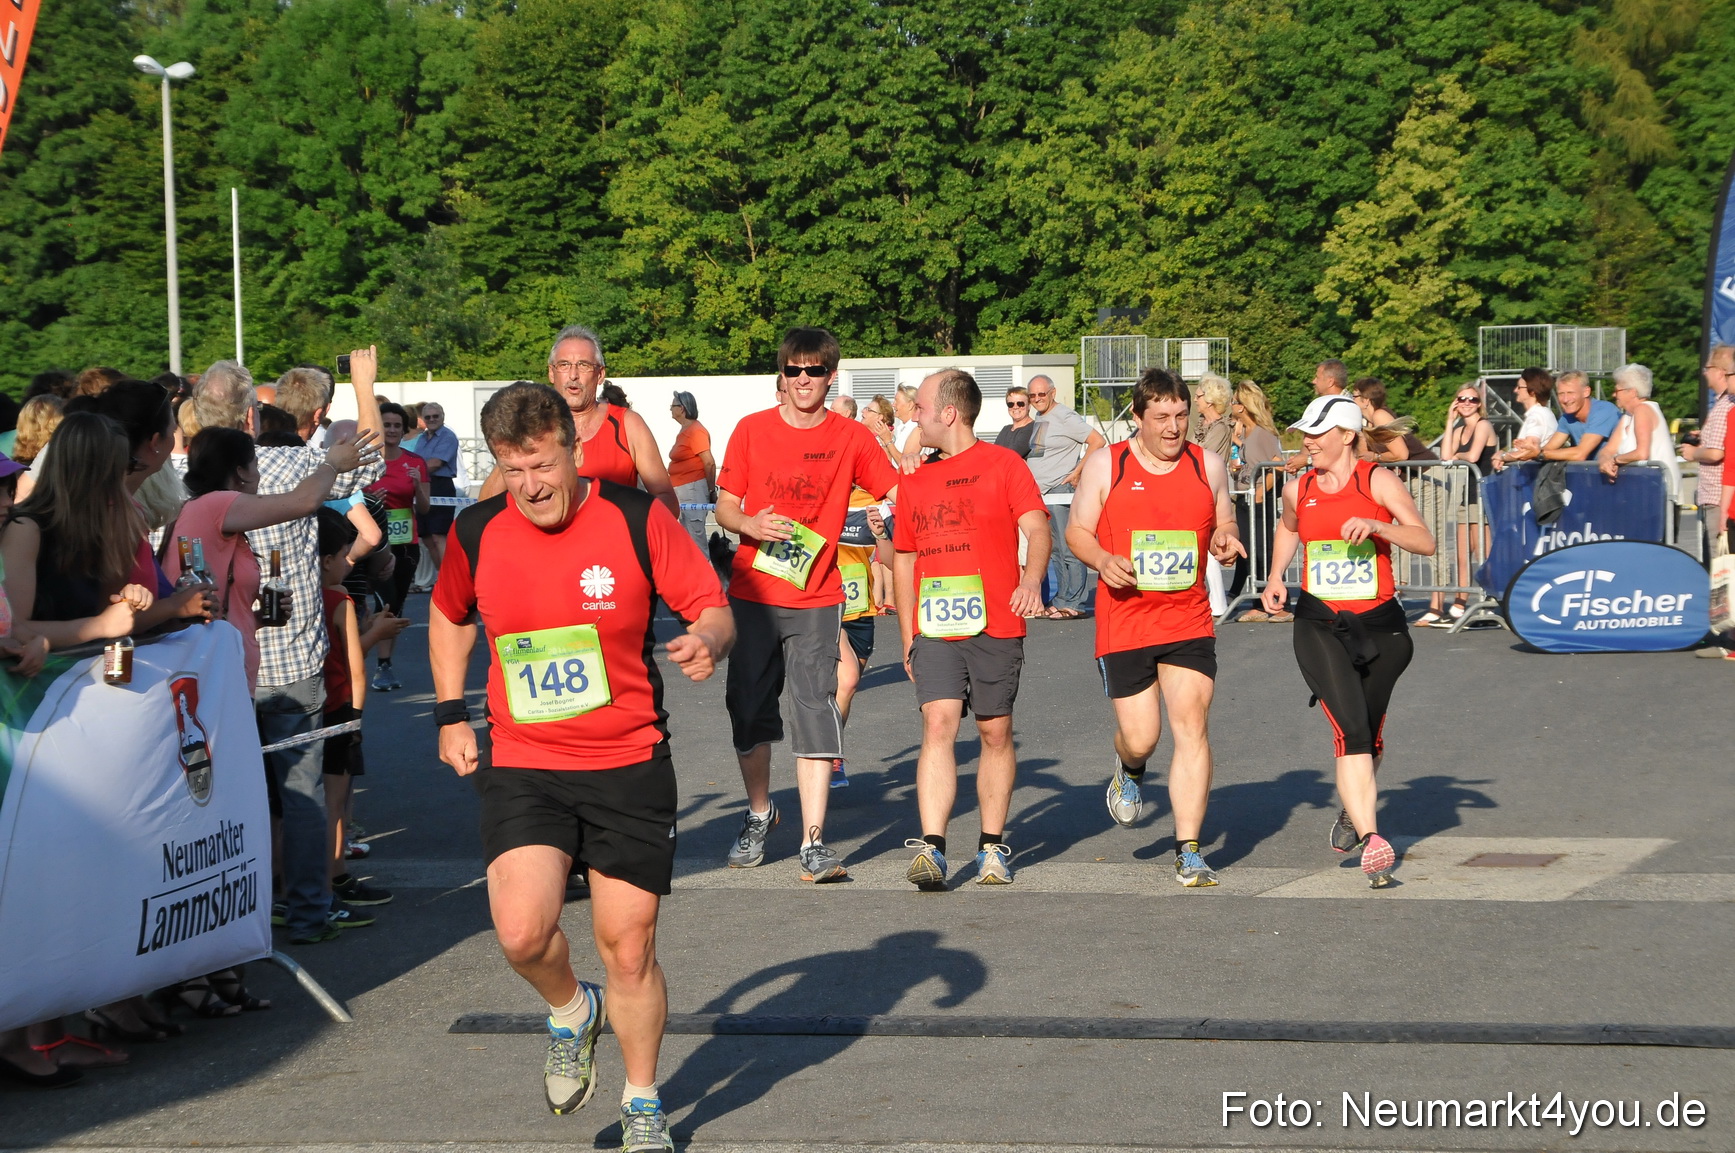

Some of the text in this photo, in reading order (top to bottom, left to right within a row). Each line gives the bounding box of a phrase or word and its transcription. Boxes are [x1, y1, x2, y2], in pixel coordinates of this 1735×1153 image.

[803, 452, 825, 460] swn
[945, 477, 969, 487] swn
[766, 540, 812, 573] 1357
[918, 543, 971, 559] Alles läuft
[1133, 552, 1195, 575] 1324
[1310, 560, 1374, 585] 1323
[582, 600, 616, 611] caritas
[920, 597, 983, 622] 1356
[1560, 589, 1693, 617] Fischer
[1574, 615, 1683, 631] AUTOMOBILE
[512, 644, 546, 655] firmenlauf
[519, 658, 589, 699] 148
[548, 704, 580, 713] Sozialstation
[554, 698, 575, 706] Bogner
[162, 820, 245, 883] Neumarkter
[136, 864, 257, 957] Lammsbräu
